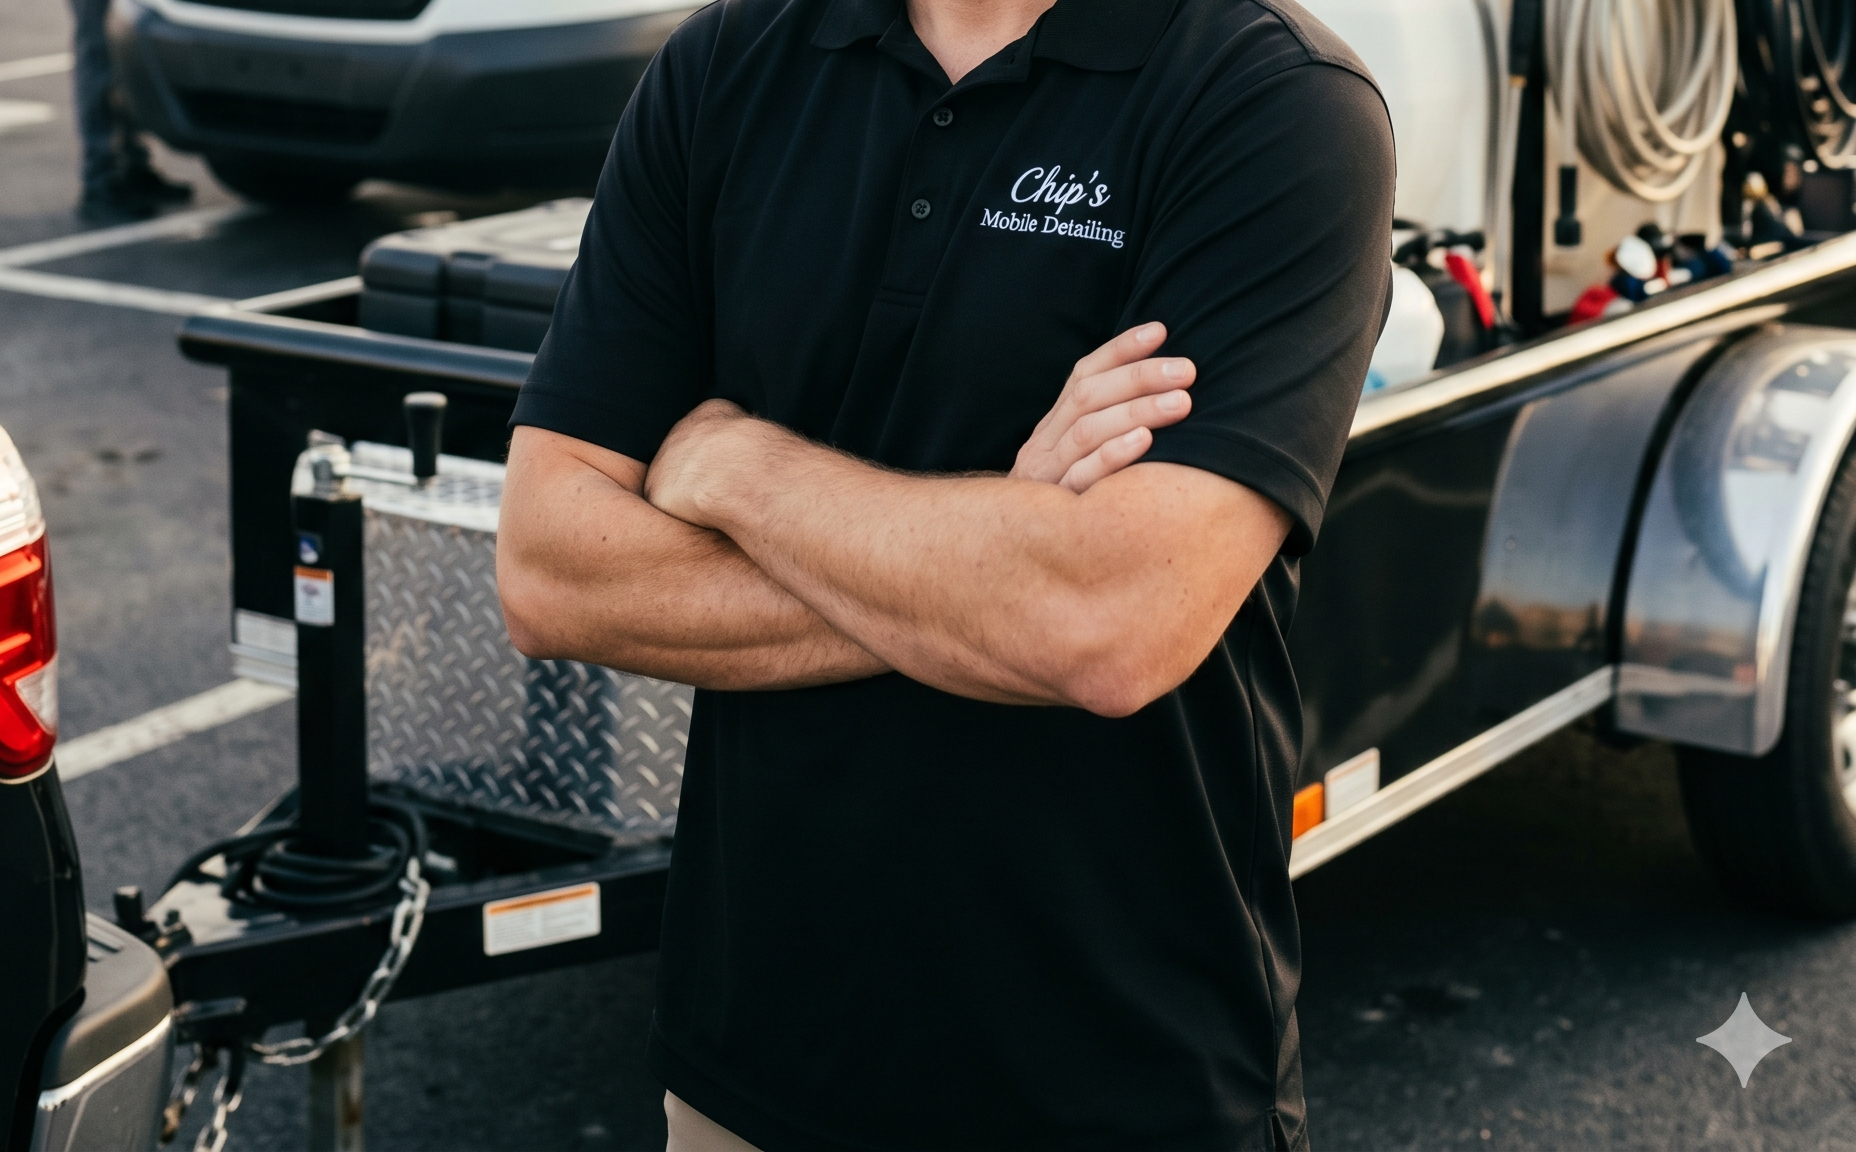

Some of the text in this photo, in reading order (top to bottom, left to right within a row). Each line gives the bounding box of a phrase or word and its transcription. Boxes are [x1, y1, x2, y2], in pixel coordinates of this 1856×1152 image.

[1010, 164, 1111, 215] Chip's
[979, 207, 1126, 249] Mobile Detailing
